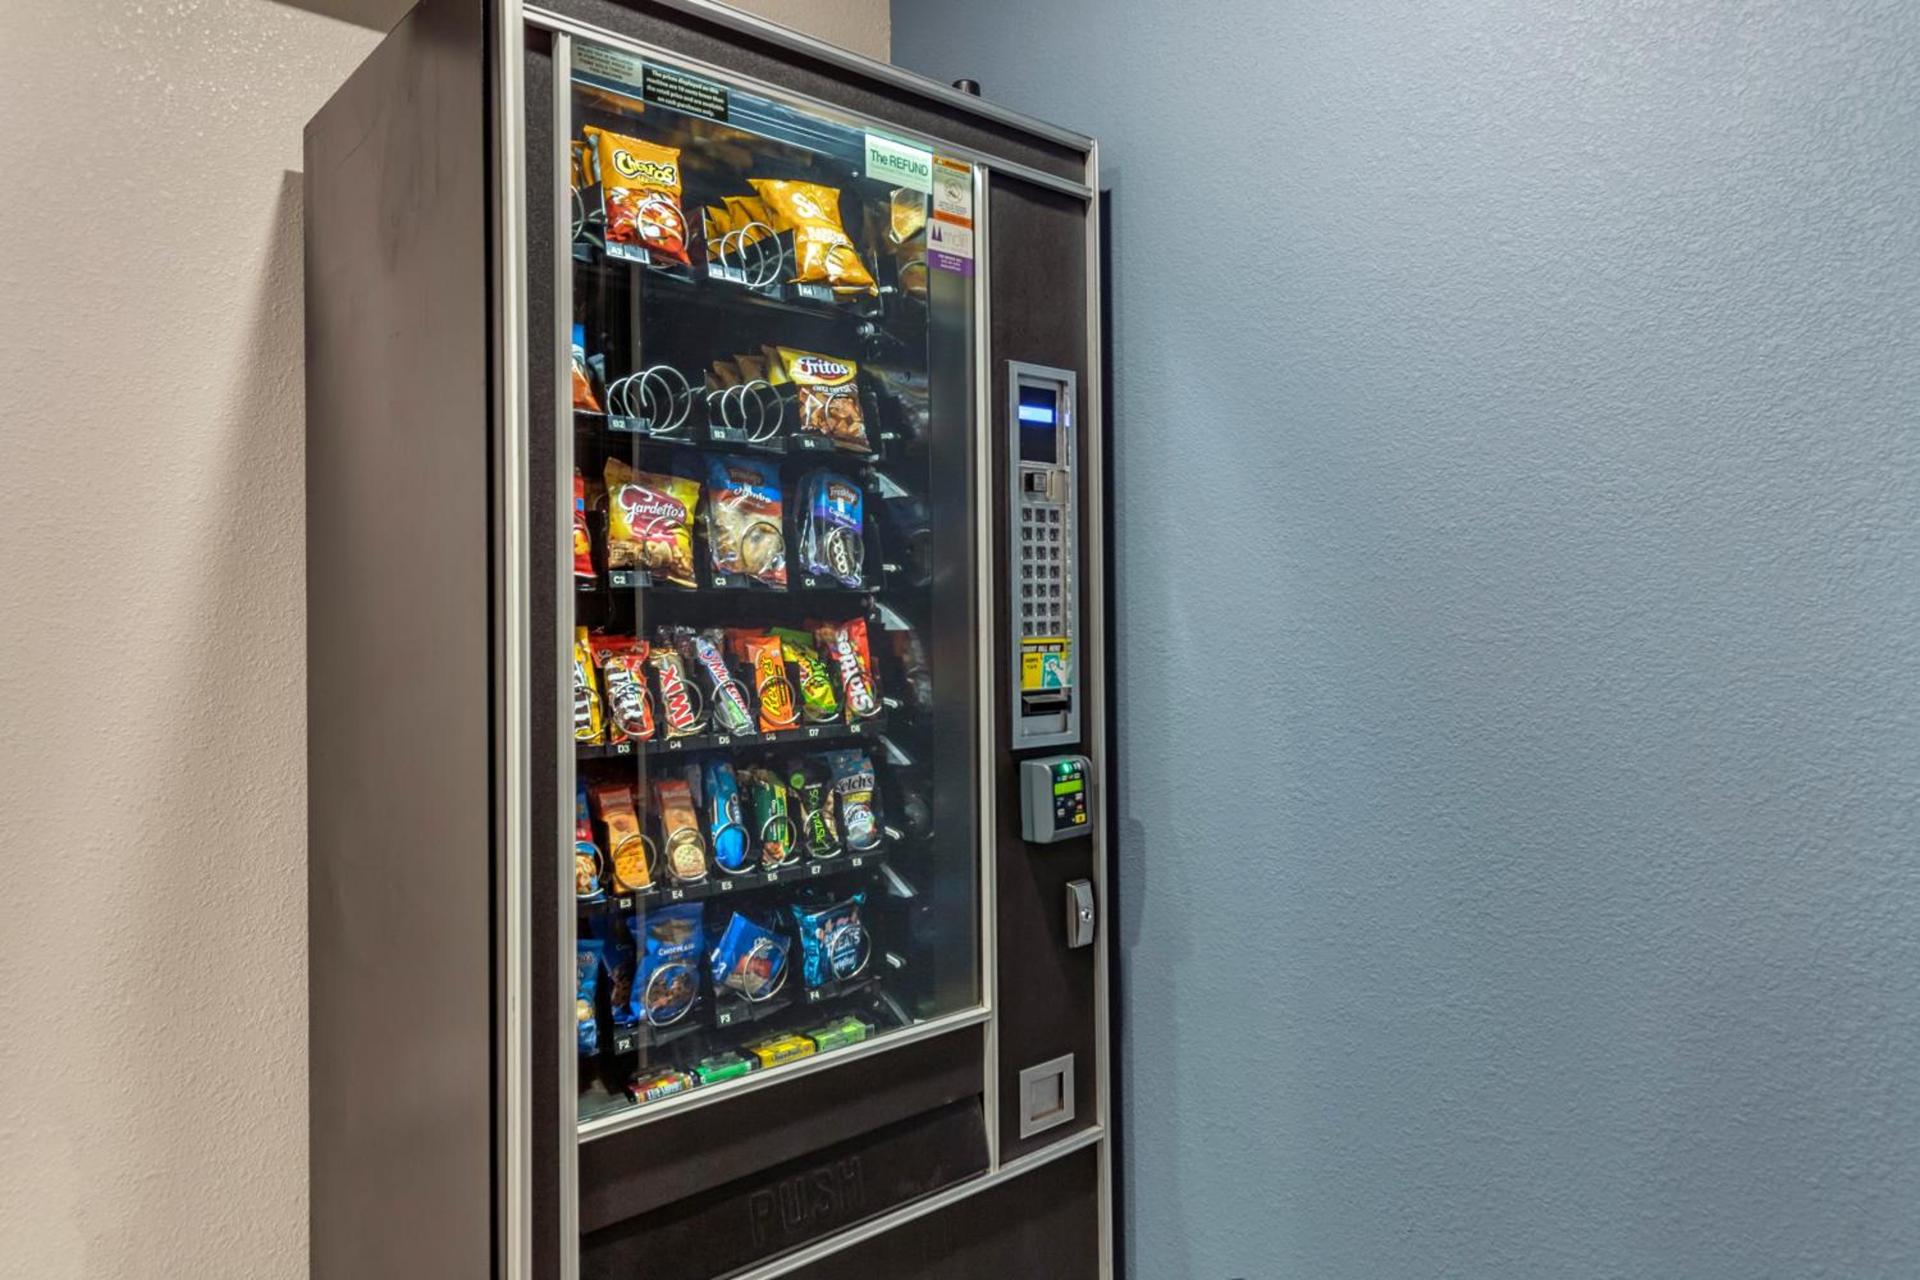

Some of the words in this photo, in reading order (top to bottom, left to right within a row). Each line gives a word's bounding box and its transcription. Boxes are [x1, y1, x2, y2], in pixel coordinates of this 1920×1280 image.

[870, 149, 888, 165] The
[889, 155, 929, 176] REFUND
[799, 356, 849, 375] Fritos
[804, 439, 815, 448] B4
[620, 483, 685, 523] Gardetto's
[613, 575, 626, 584] C2
[715, 577, 726, 585] C3
[805, 578, 816, 586] C4
[659, 664, 695, 728] TWIX
[809, 728, 819, 736] D7
[670, 739, 681, 749] D4
[719, 735, 730, 744] D5
[618, 744, 630, 753] D3
[721, 880, 733, 890] E5
[672, 889, 684, 899] E4
[809, 990, 820, 1000] F4
[720, 1013, 731, 1024] F3
[618, 1040, 631, 1050] F2
[750, 1156, 864, 1247] PUSH
